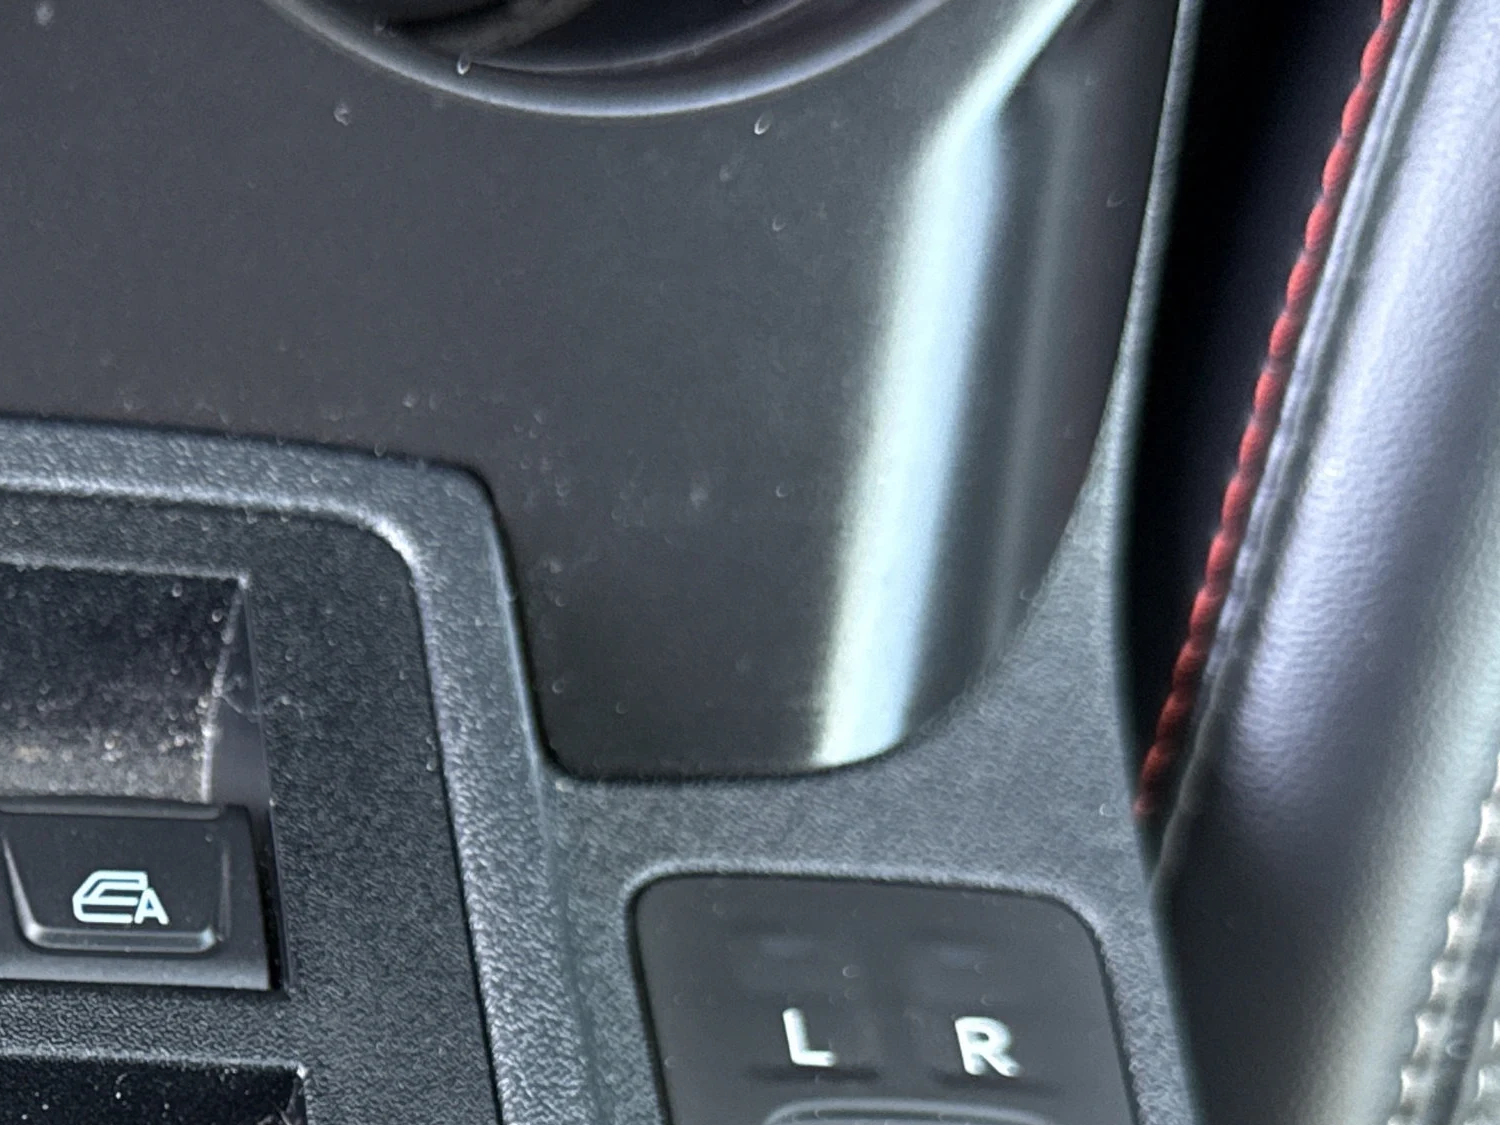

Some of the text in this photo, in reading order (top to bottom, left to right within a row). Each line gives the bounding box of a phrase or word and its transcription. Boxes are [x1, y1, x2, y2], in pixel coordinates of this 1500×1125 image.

[135, 888, 169, 925] A
[782, 1007, 837, 1067] L
[954, 1016, 1022, 1077] R
